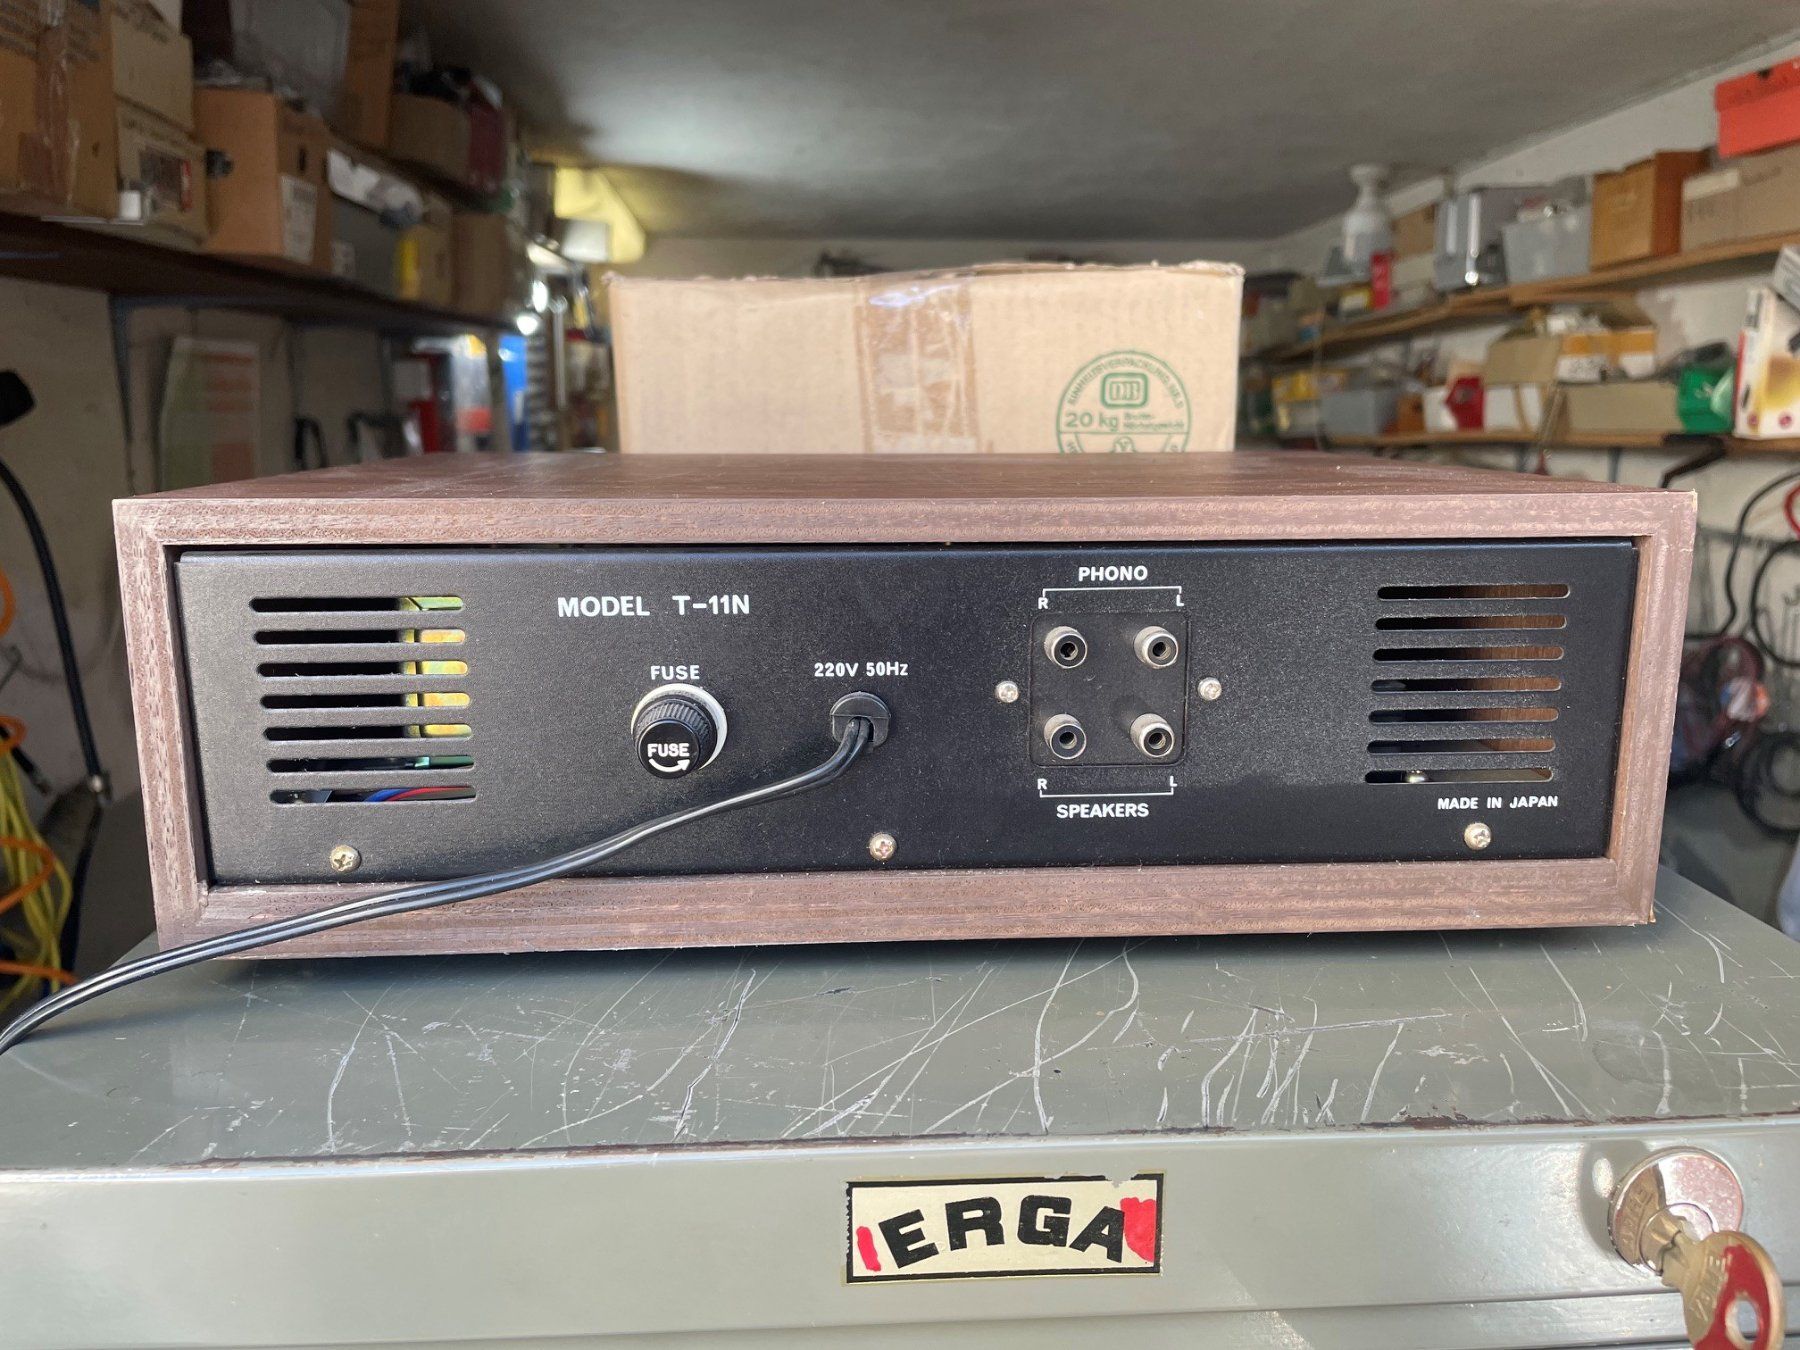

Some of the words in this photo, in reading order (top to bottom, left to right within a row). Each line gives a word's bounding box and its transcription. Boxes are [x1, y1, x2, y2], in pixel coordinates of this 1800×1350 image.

[1065, 412, 1093, 428] 20
[1099, 412, 1119, 432] kg
[1078, 565, 1148, 582] PHONO
[557, 595, 650, 617] MODEL
[672, 594, 750, 616] T-11N
[1037, 597, 1049, 610] R
[1176, 594, 1185, 607] L
[650, 664, 700, 680] FUSE
[814, 662, 859, 677] 220V
[866, 661, 909, 677] 50Hz
[647, 742, 690, 758] FUSE
[1037, 778, 1048, 790] R
[1169, 775, 1178, 787] L
[1056, 802, 1150, 819] SPEAKERS
[1437, 797, 1479, 810] MADE
[1486, 796, 1503, 809] IN
[1509, 795, 1559, 809] JAPAN
[878, 1195, 1126, 1269] ERGA
